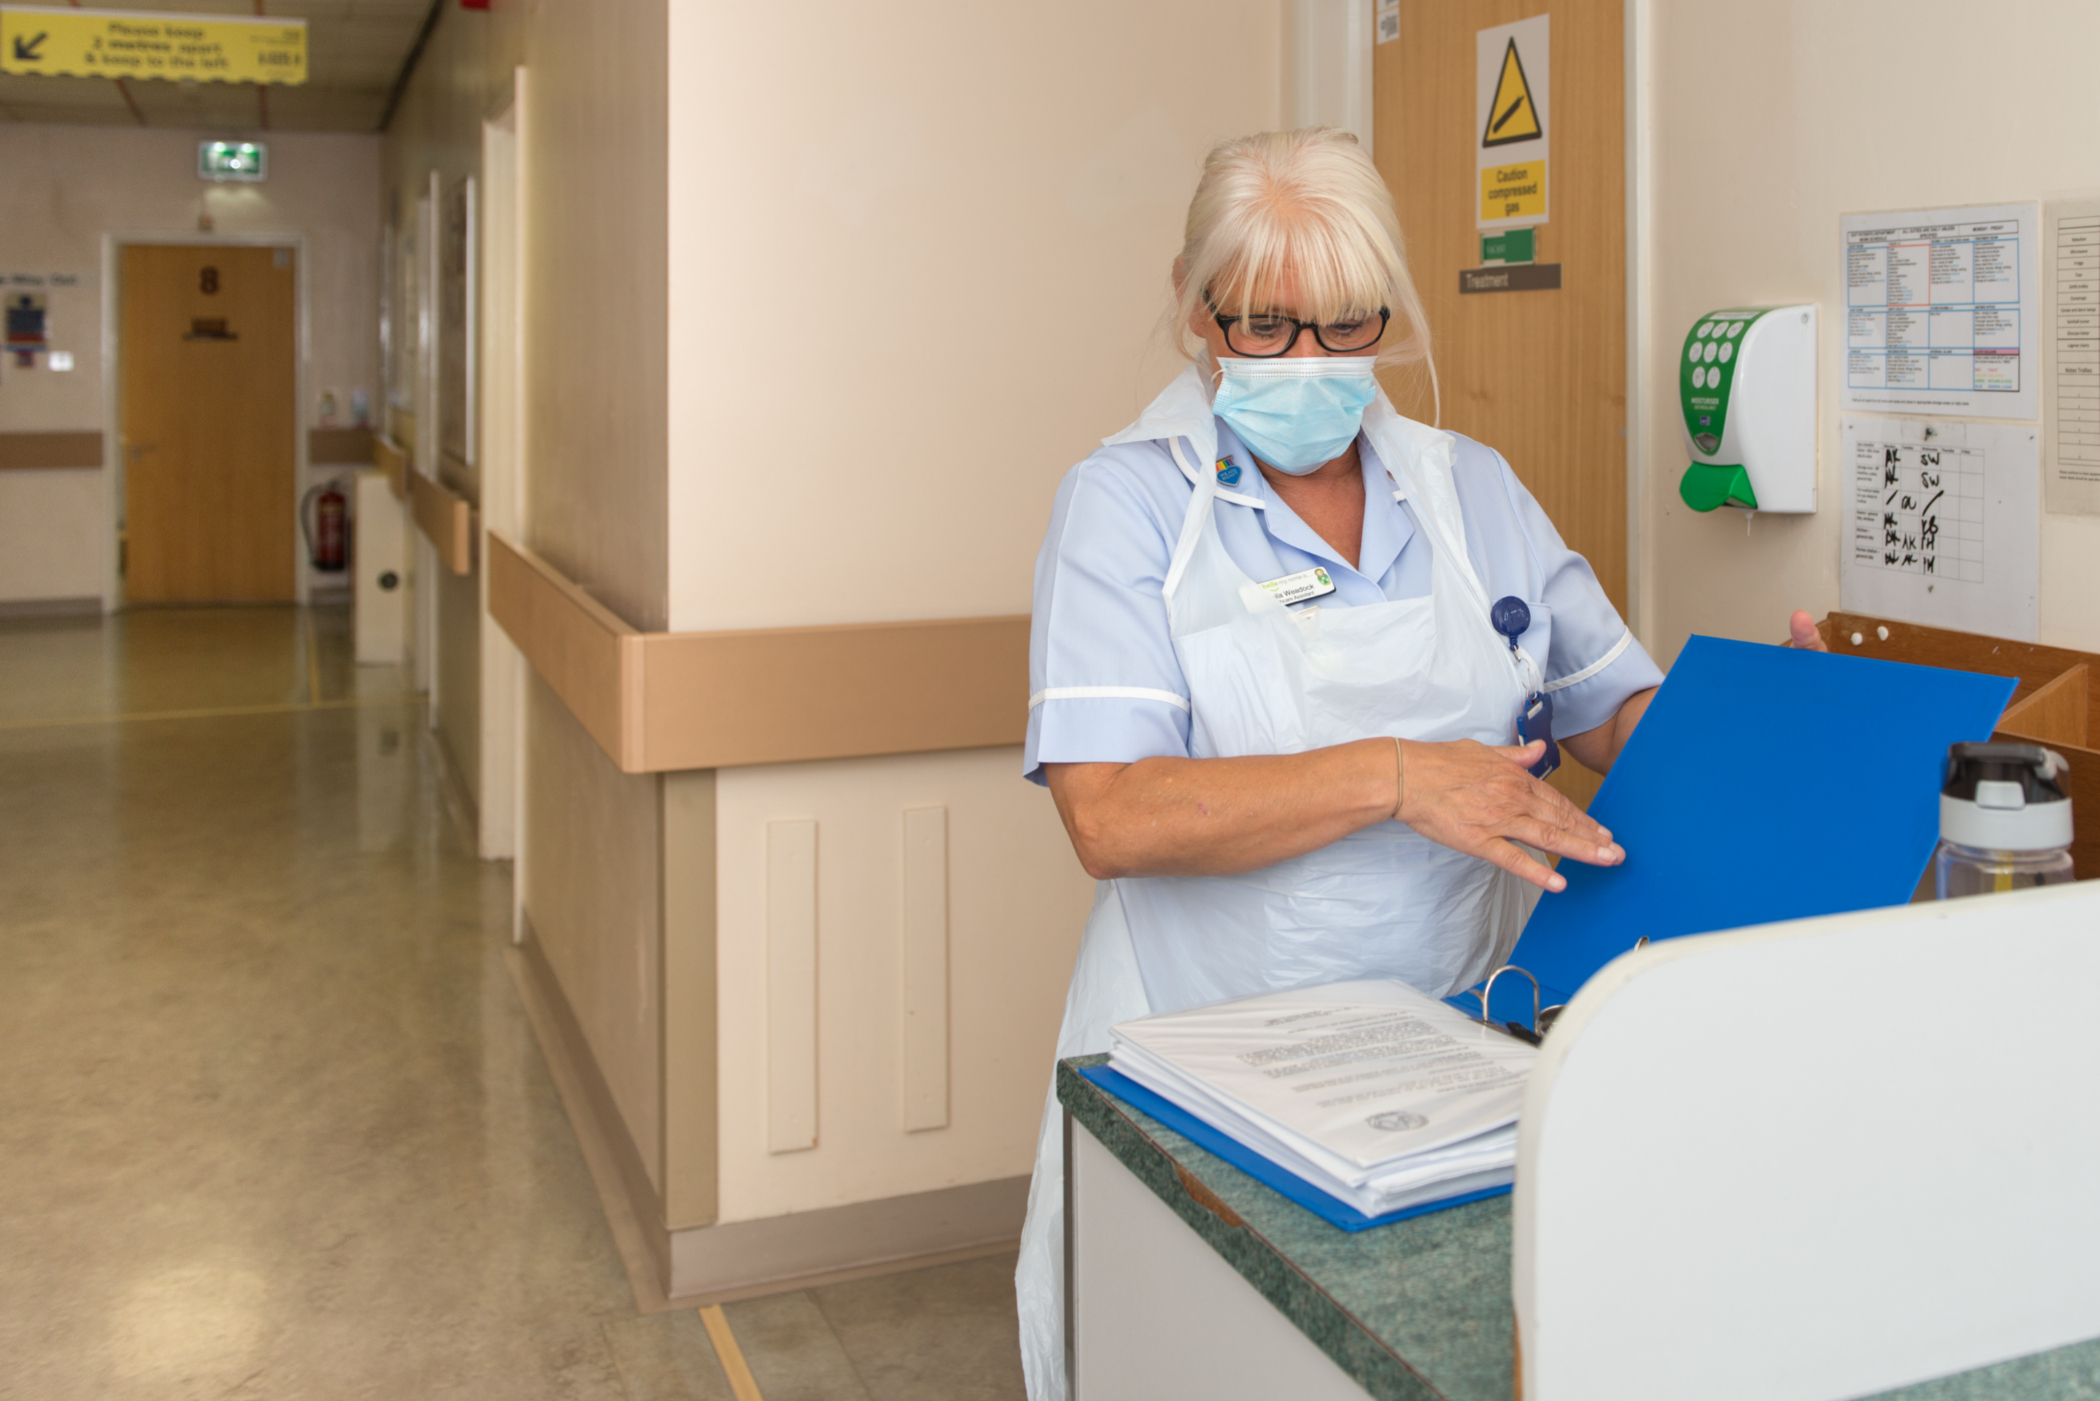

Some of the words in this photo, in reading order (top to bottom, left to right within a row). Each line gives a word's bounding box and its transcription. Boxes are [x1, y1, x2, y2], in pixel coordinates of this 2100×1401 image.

[107, 22, 159, 37] Please
[165, 23, 204, 39] keep
[108, 38, 172, 52] metres
[178, 43, 223, 56] apart
[102, 53, 141, 69] keep
[146, 54, 163, 67] to
[170, 54, 196, 69] the
[201, 56, 229, 71] left
[1496, 168, 1528, 183] Caution
[1488, 181, 1538, 200] compressed
[1505, 202, 1520, 217] gas
[200, 266, 219, 295] 8
[1465, 272, 1509, 289] Treatment
[2065, 366, 2078, 374] Notes
[1261, 581, 1279, 589] hello
[1288, 575, 1303, 583] name
[1284, 584, 1315, 597] Weadock
[1294, 590, 1315, 600] Assistant
